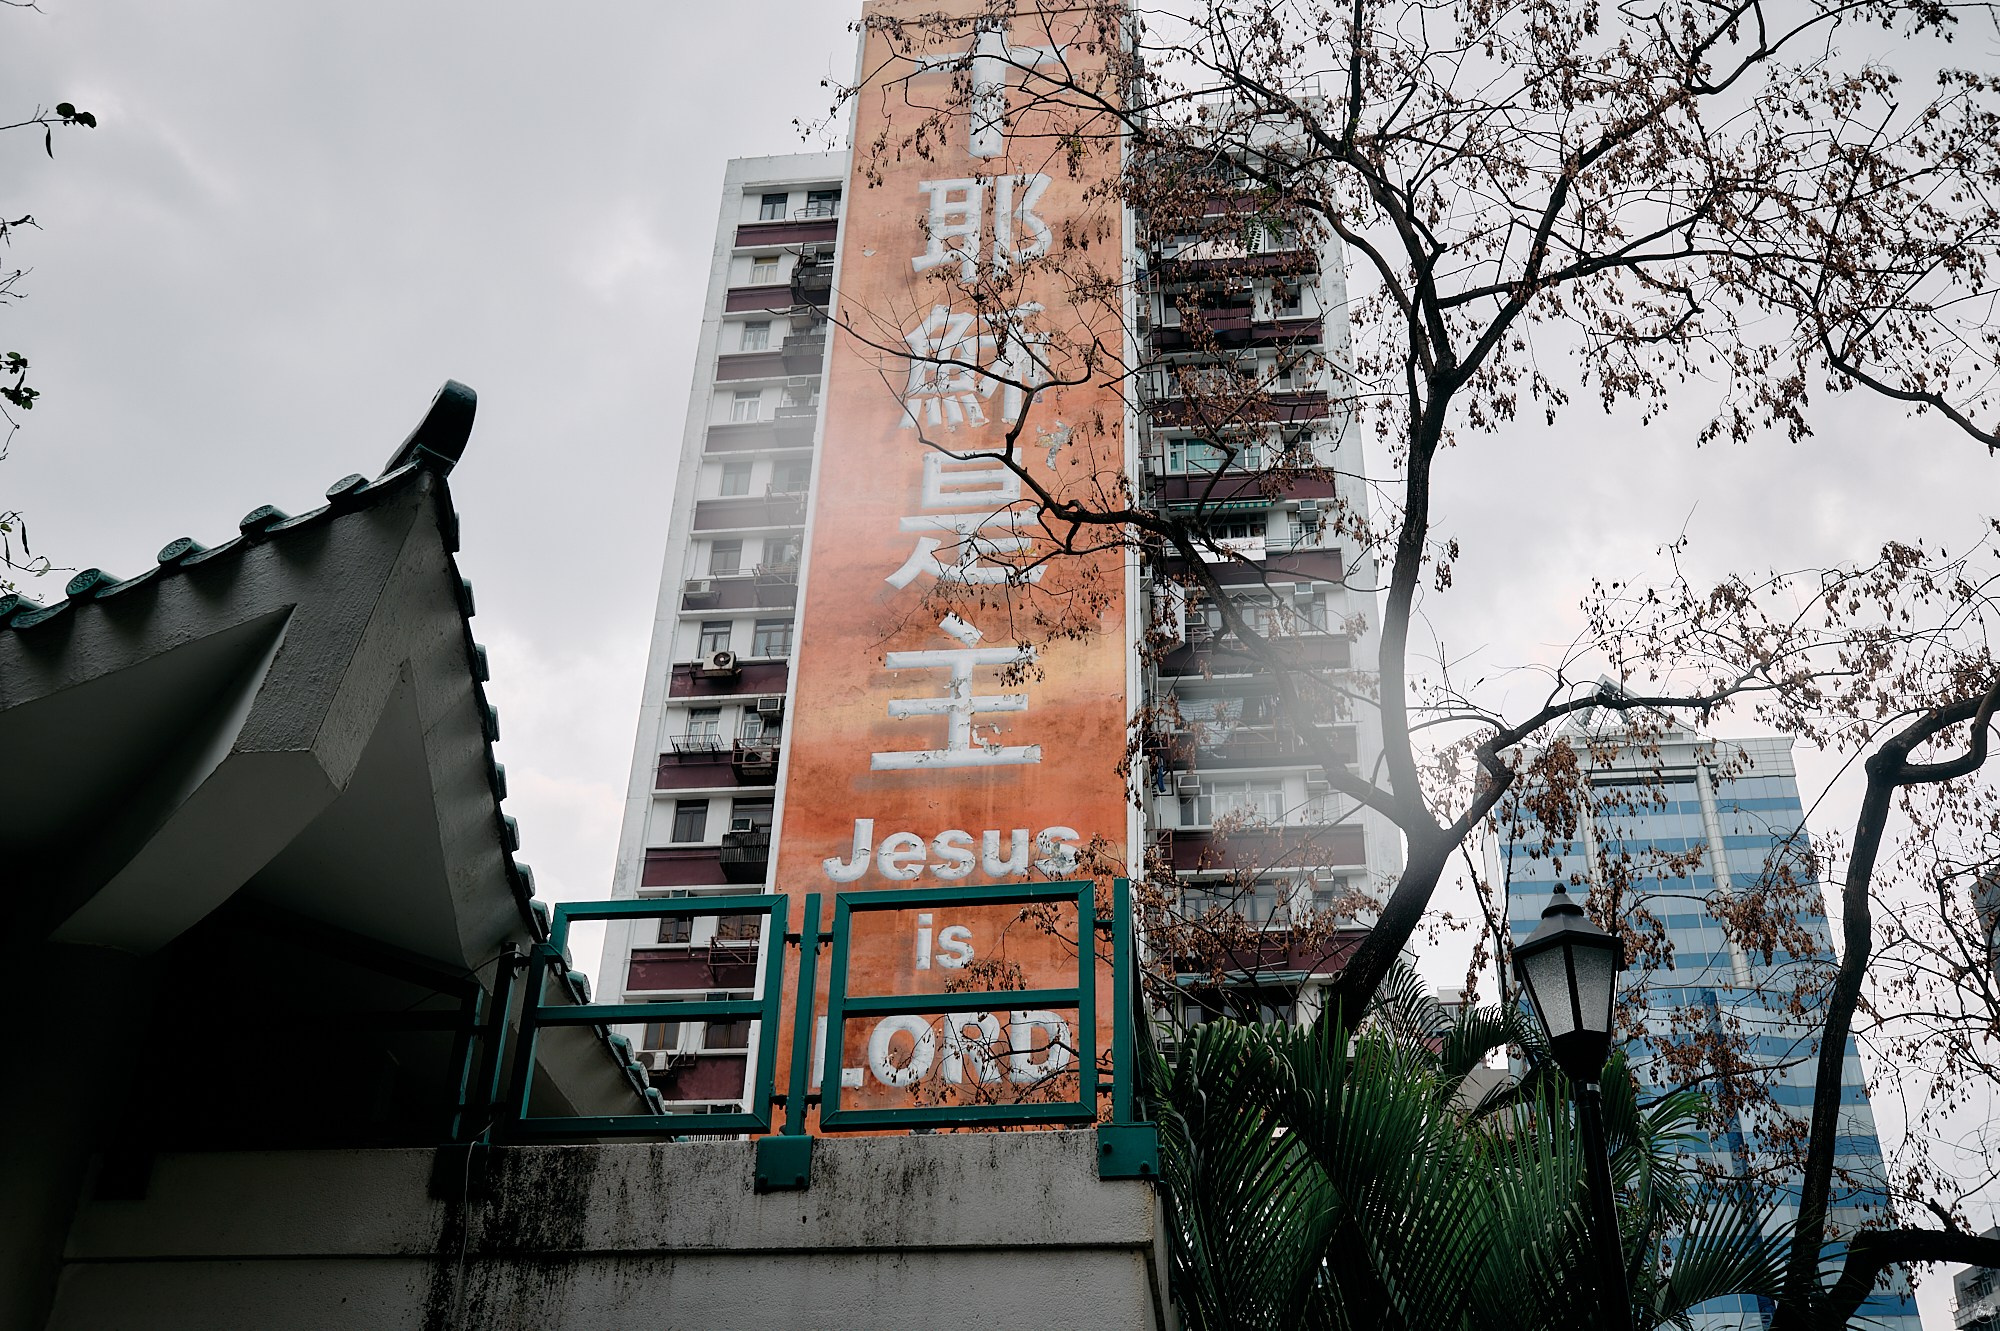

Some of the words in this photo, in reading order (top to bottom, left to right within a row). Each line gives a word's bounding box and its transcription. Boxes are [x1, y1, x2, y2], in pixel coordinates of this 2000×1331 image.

[822, 818, 1081, 882] Jesus
[915, 913, 975, 970] is
[812, 1009, 1072, 1088] LORD
